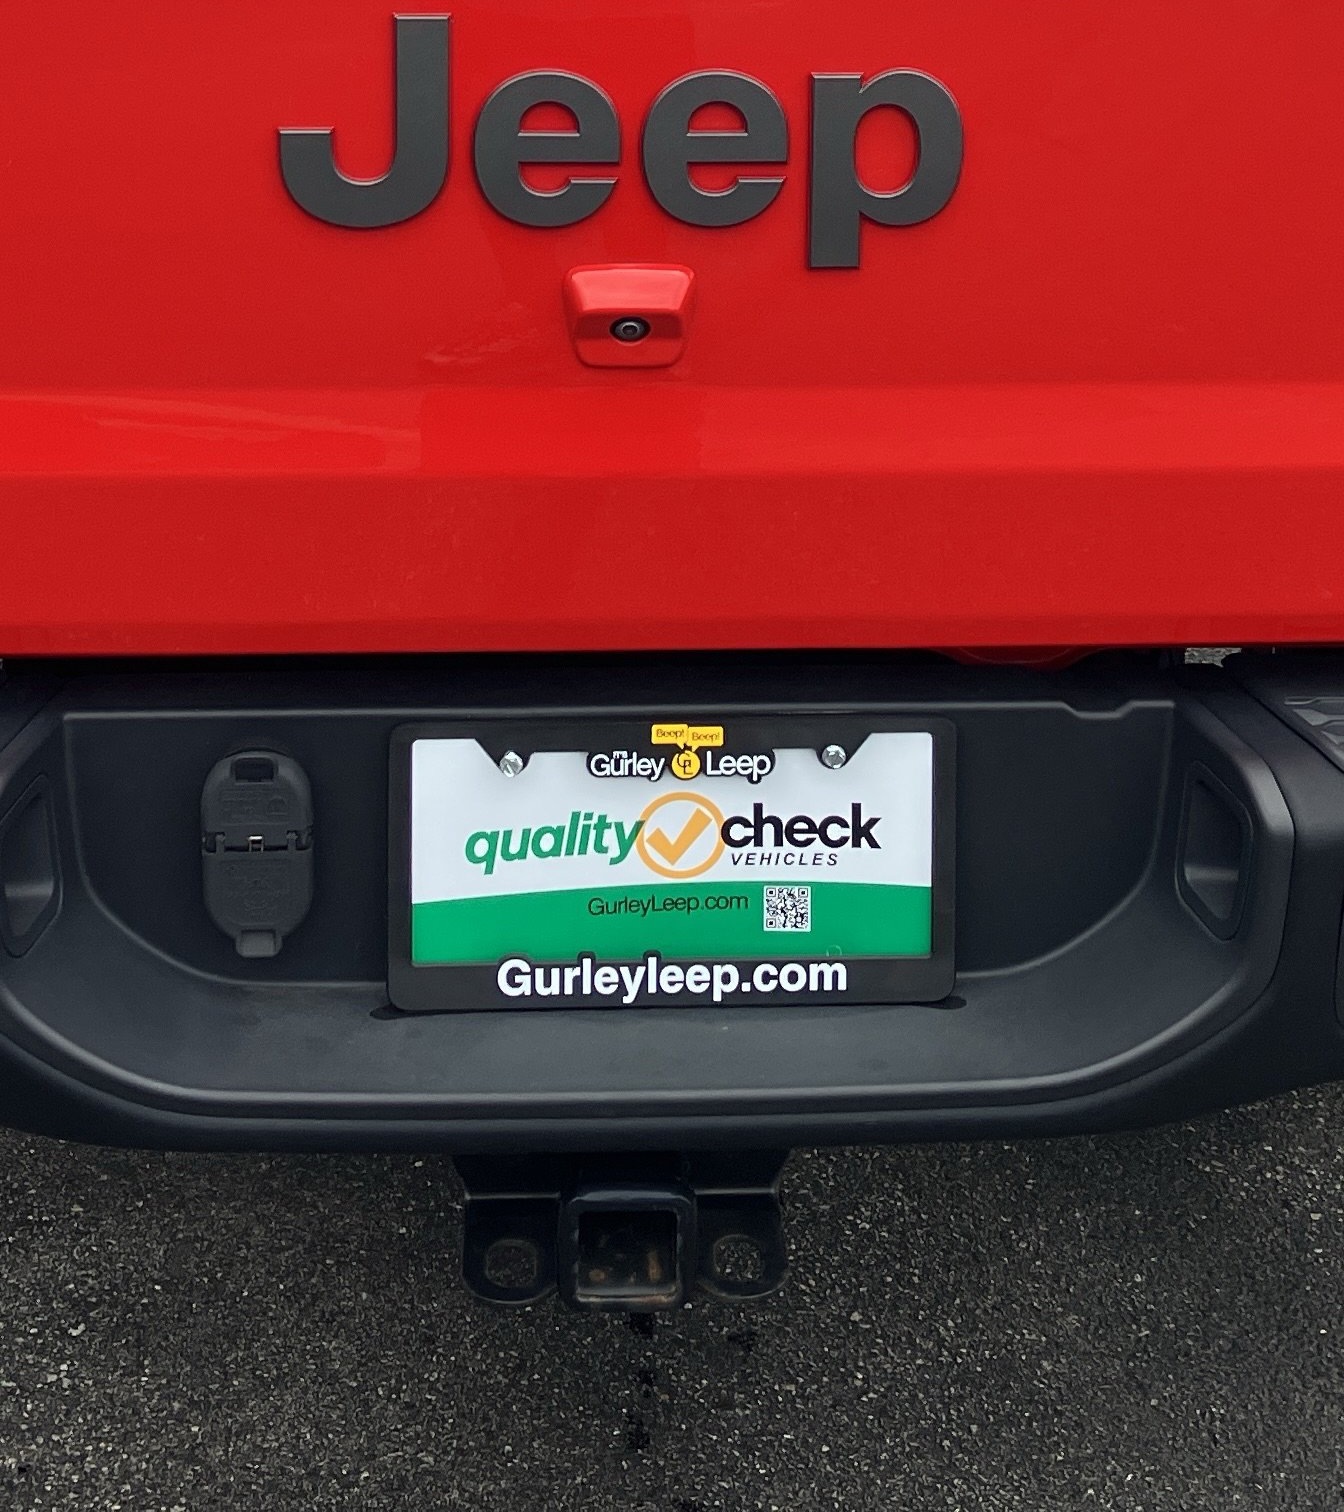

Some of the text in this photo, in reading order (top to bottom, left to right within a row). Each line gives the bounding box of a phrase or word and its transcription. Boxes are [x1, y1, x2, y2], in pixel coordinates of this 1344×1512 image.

[278, 12, 964, 270] Jeep
[590, 751, 665, 781] Gurley
[706, 751, 771, 781] Leep
[465, 802, 882, 876] quality check
[730, 851, 839, 867] VEHICLES
[587, 894, 749, 919] GurleyLeep.com
[497, 956, 848, 1004] Gurleyleep.com
